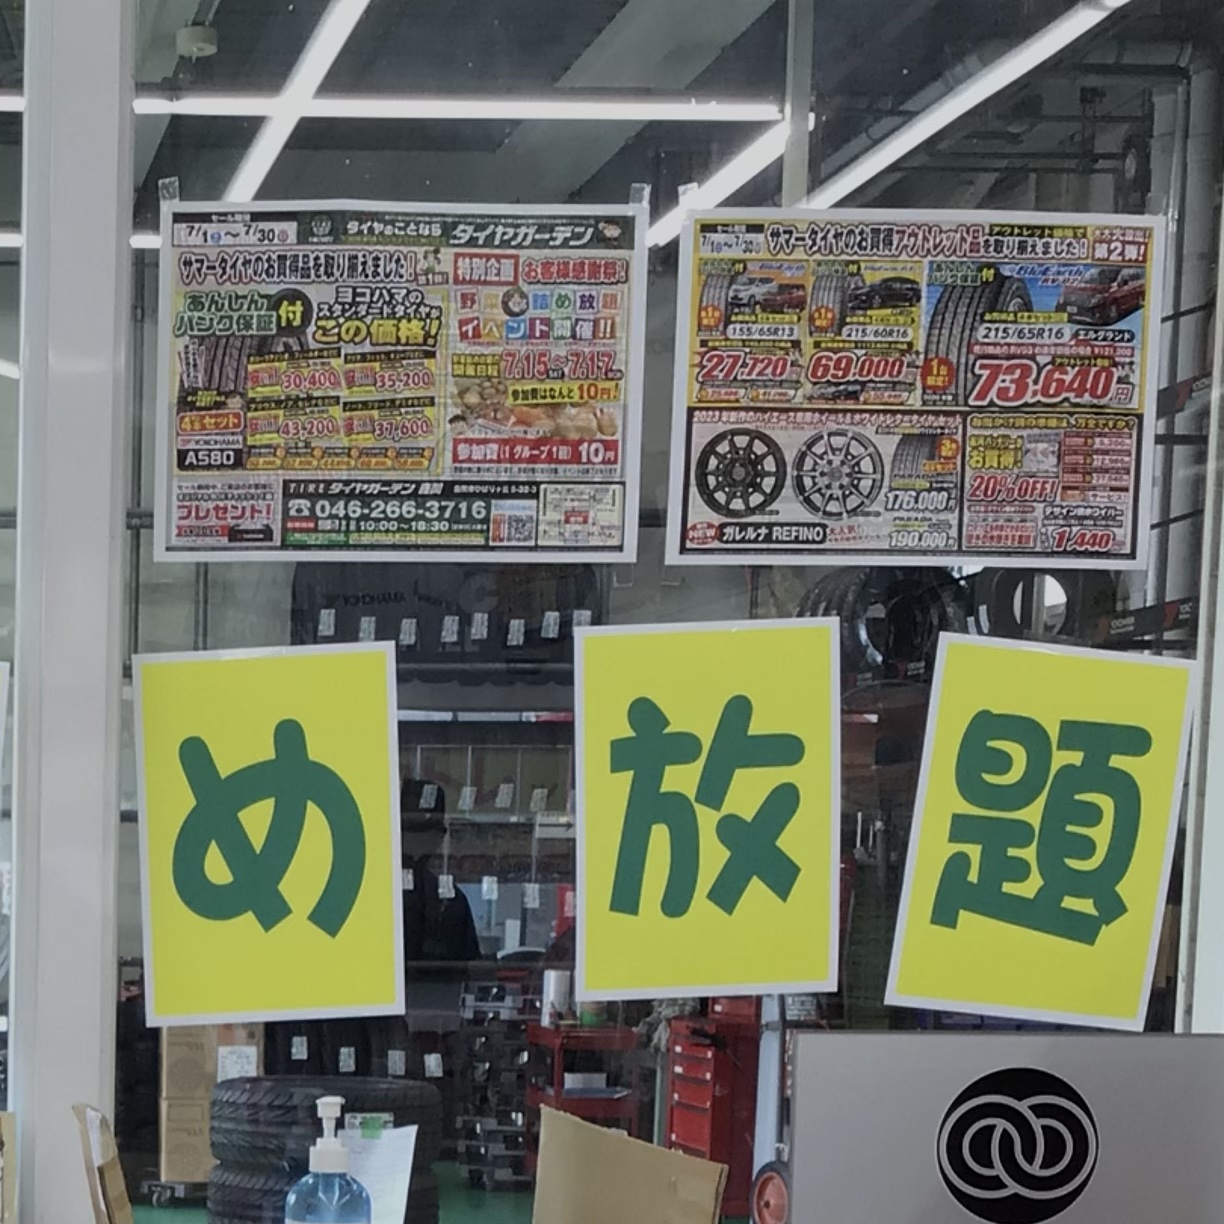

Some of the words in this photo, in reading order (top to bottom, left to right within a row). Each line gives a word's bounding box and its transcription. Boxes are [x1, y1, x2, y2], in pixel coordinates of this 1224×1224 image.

[449, 225, 594, 246] タイヤガーデン
[457, 258, 516, 281] 特別企画
[1014, 266, 1085, 277] BluEarth
[184, 291, 267, 312] あんしん
[173, 312, 276, 335] パンク保証
[279, 301, 304, 326] 付
[731, 328, 794, 338] 155/65R13
[845, 329, 909, 339] 215/60R16
[982, 326, 1065, 340] 215/65R16
[1078, 330, 1132, 341] エルグランド
[194, 438, 242, 446] YOKOHAMA
[184, 451, 235, 466] A580
[328, 483, 416, 494] タイヤガーデン
[315, 500, 487, 518] 046-266-3716
[688, 527, 717, 538] NEW
[722, 526, 769, 541] ガレルナ
[772, 526, 823, 541] REFINO
[172, 719, 366, 937] め
[610, 694, 805, 917] 放
[931, 709, 1152, 945] 題
